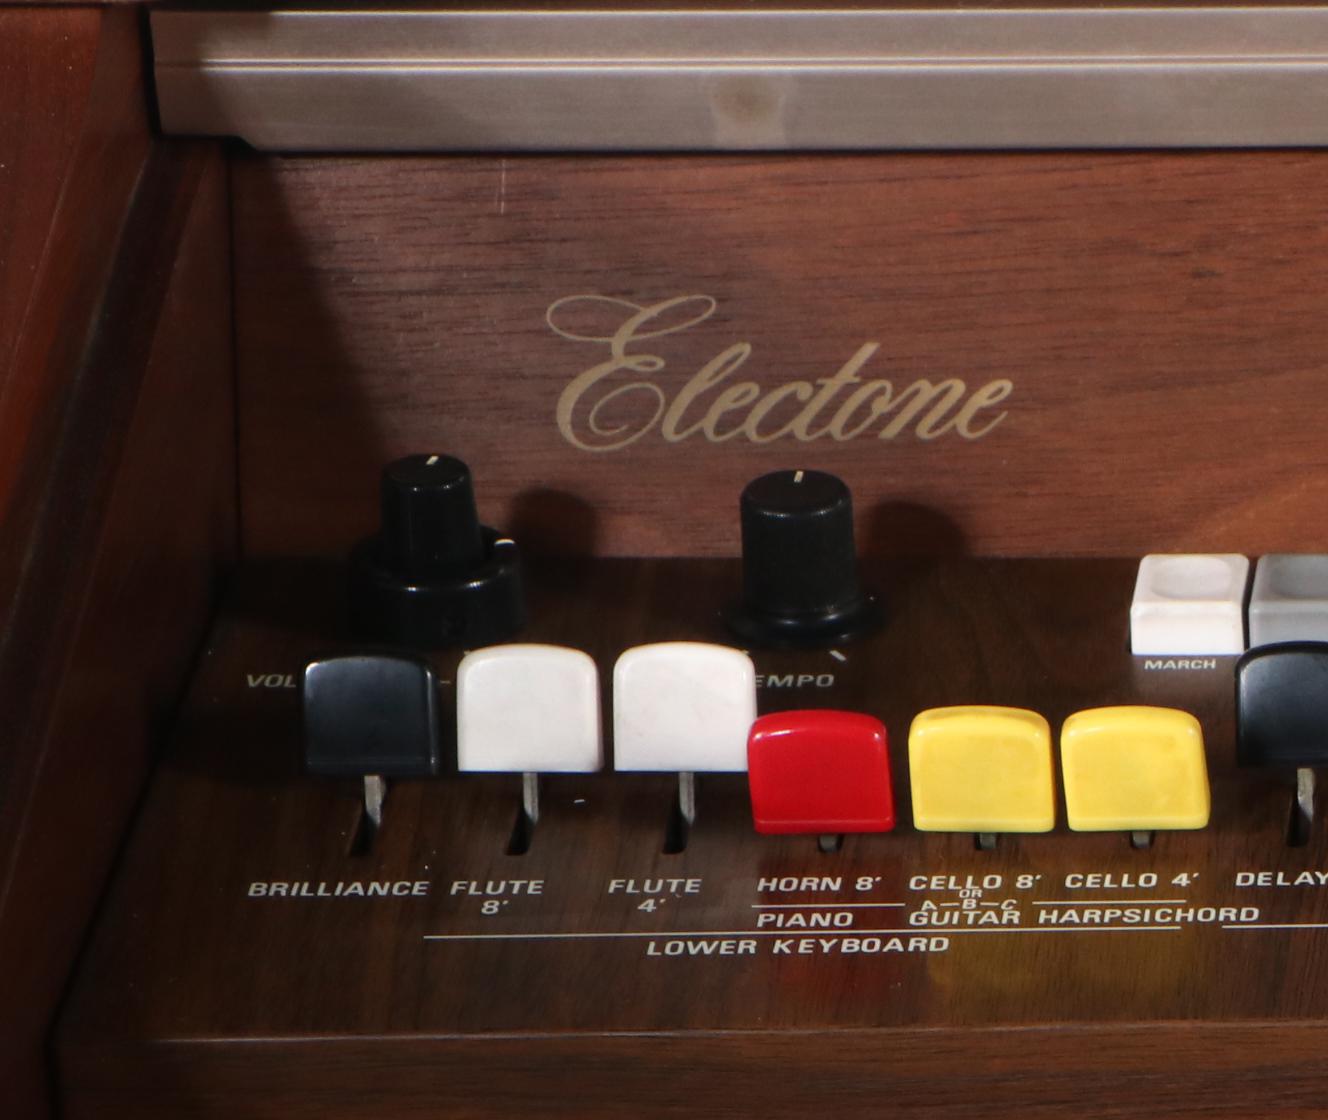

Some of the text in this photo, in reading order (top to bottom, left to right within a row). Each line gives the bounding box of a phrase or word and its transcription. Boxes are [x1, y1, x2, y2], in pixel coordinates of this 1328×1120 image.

[547, 295, 1013, 452] Electone
[1144, 658, 1216, 671] MARCH
[247, 674, 296, 688] VOL
[754, 674, 834, 688] EMPO
[450, 880, 544, 895] FLUTE
[608, 879, 702, 894] FLUTE
[757, 877, 842, 892] HORN
[909, 875, 1002, 891] CELLO
[1064, 873, 1158, 889] CELLO
[248, 881, 428, 897] BRILLIANCE
[959, 888, 983, 898] OR
[757, 913, 854, 928] PIANO
[909, 910, 1021, 926] GUITAR
[1038, 907, 1260, 924] HARPSICHORD
[647, 937, 949, 956] LOWER KEYBOARD
